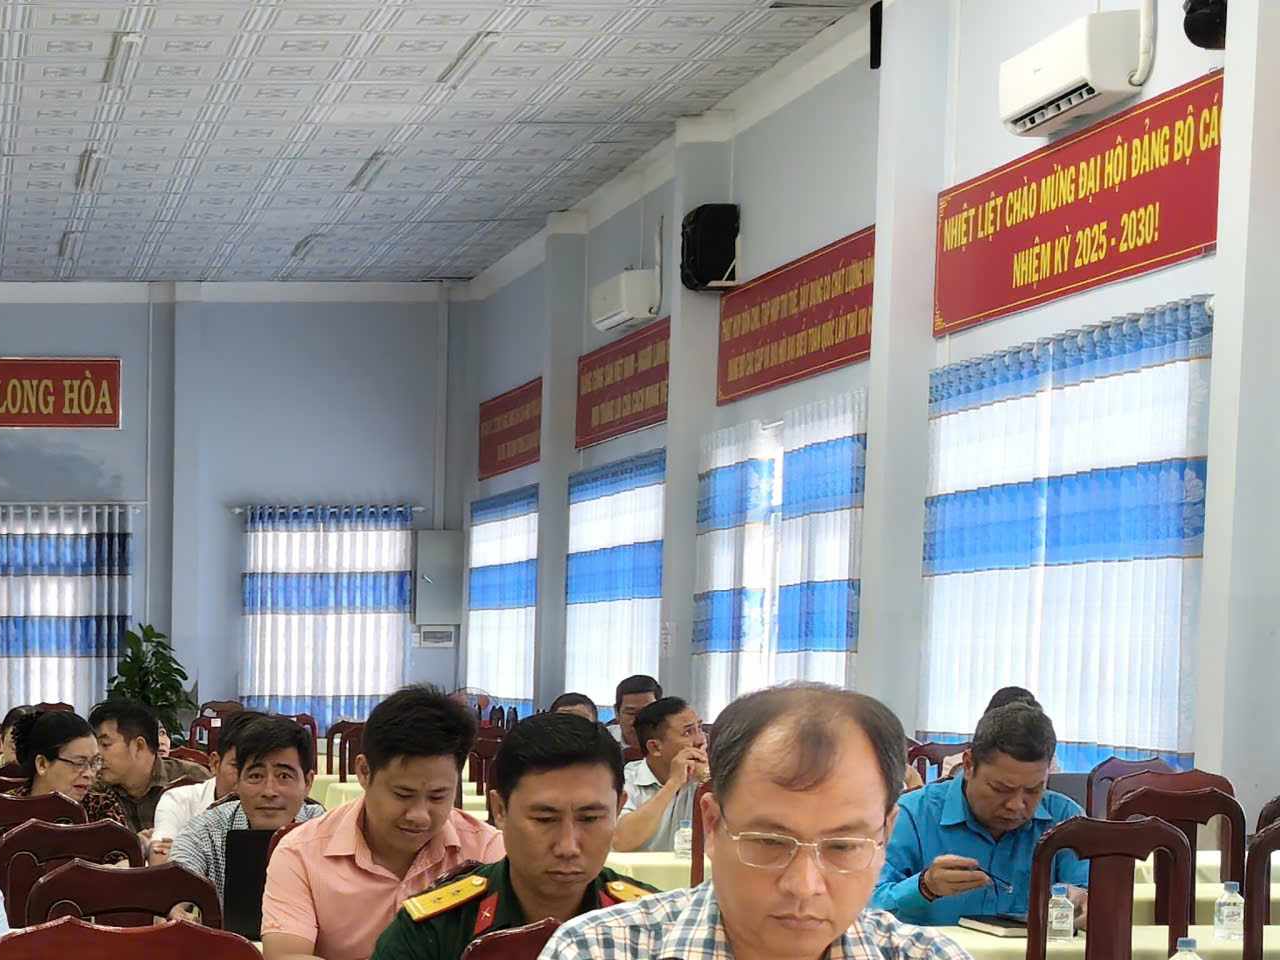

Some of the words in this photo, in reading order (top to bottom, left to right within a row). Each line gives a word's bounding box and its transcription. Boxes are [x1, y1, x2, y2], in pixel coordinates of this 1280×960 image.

[943, 202, 976, 252] NHIỆT
[977, 191, 1004, 242] LIỆT
[1005, 175, 1038, 228] CHÀO
[1040, 163, 1076, 214] MỪNG
[1078, 155, 1101, 203] ĐẠI
[1104, 135, 1128, 192] HỘI
[1131, 117, 1170, 178] ĐẢNG
[1173, 104, 1195, 166] BỘ
[1012, 236, 1052, 290] NHIỆM
[1053, 225, 1072, 275] KỲ
[1074, 220, 1108, 268] 2025
[1119, 202, 1160, 252] 2030!
[62, 369, 114, 414] HÒA
